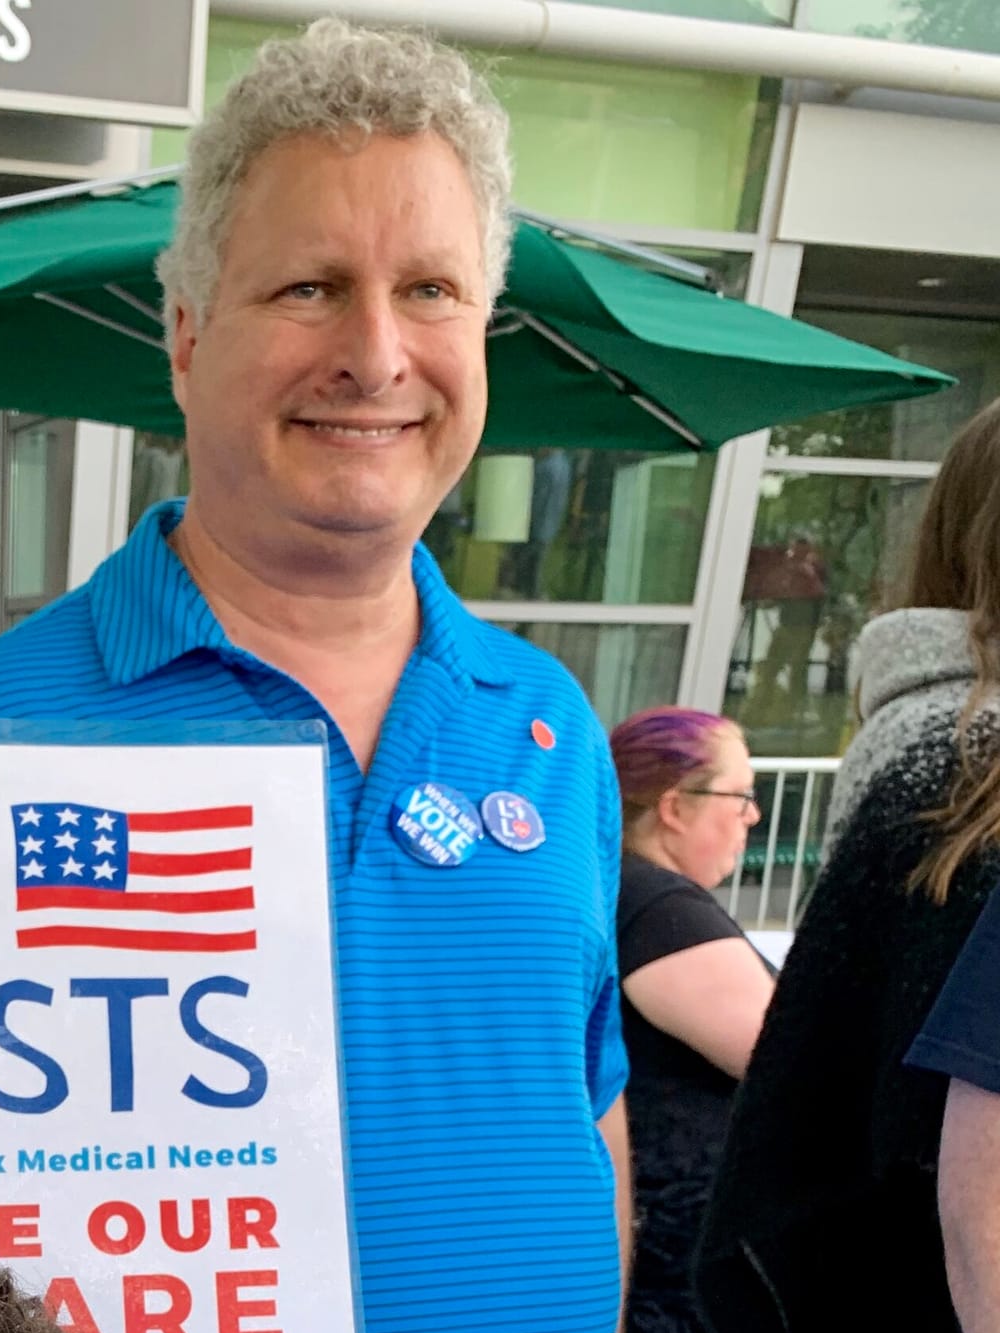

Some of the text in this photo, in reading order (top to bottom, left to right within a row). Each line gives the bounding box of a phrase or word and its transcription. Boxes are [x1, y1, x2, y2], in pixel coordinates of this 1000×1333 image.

[397, 813, 451, 864] WE WIN
[407, 789, 474, 857] VOTE
[18, 1145, 155, 1173] Medical
[168, 1142, 278, 1168] Needs
[87, 1195, 281, 1256] OUR
